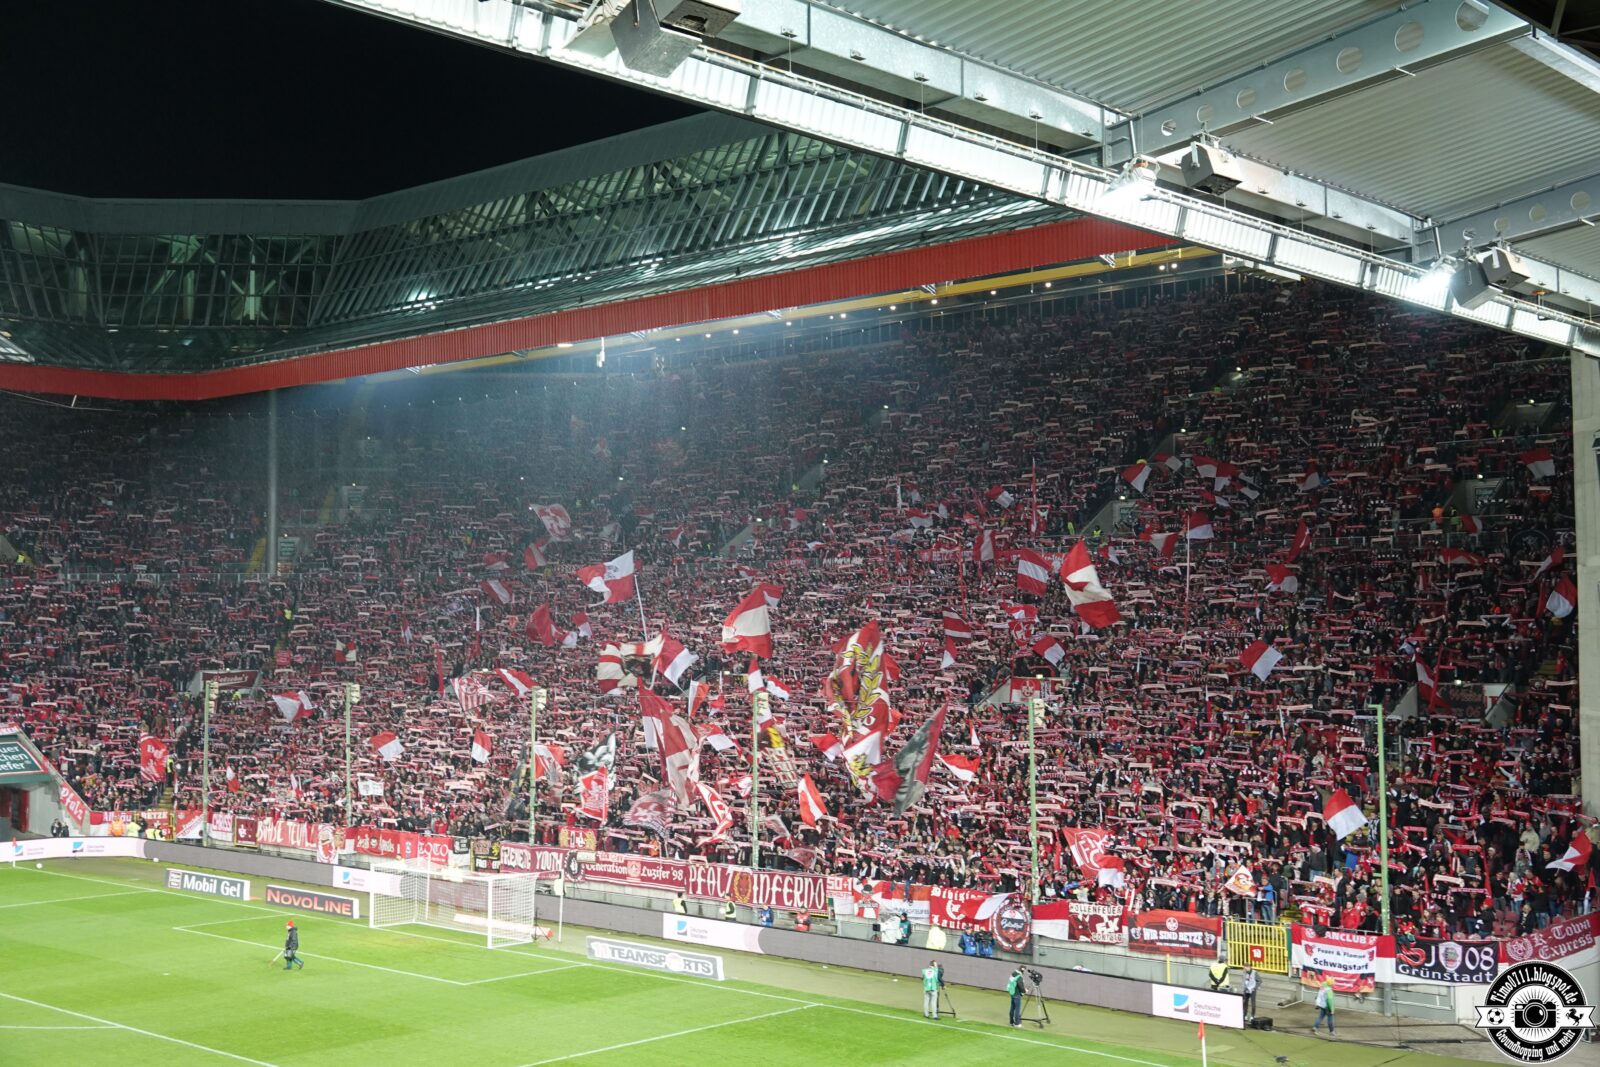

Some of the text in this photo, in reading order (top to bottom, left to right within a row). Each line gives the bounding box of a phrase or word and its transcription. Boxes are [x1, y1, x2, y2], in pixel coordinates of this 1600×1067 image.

[60, 786, 84, 821] Pfalz
[535, 850, 563, 871] YOUTH
[640, 866, 670, 881] Luzifer
[183, 874, 217, 893] Mobil
[220, 880, 241, 898] Gel
[688, 865, 825, 910] PFALZ INFERNO
[1143, 927, 1158, 940] WIR
[1159, 930, 1178, 940] SIND
[1178, 931, 1204, 946] BETZE
[1324, 931, 1367, 944] ANCLUB
[1538, 933, 1594, 960] Express
[1464, 946, 1495, 971] 08
[1398, 963, 1494, 983] Grünstadt
